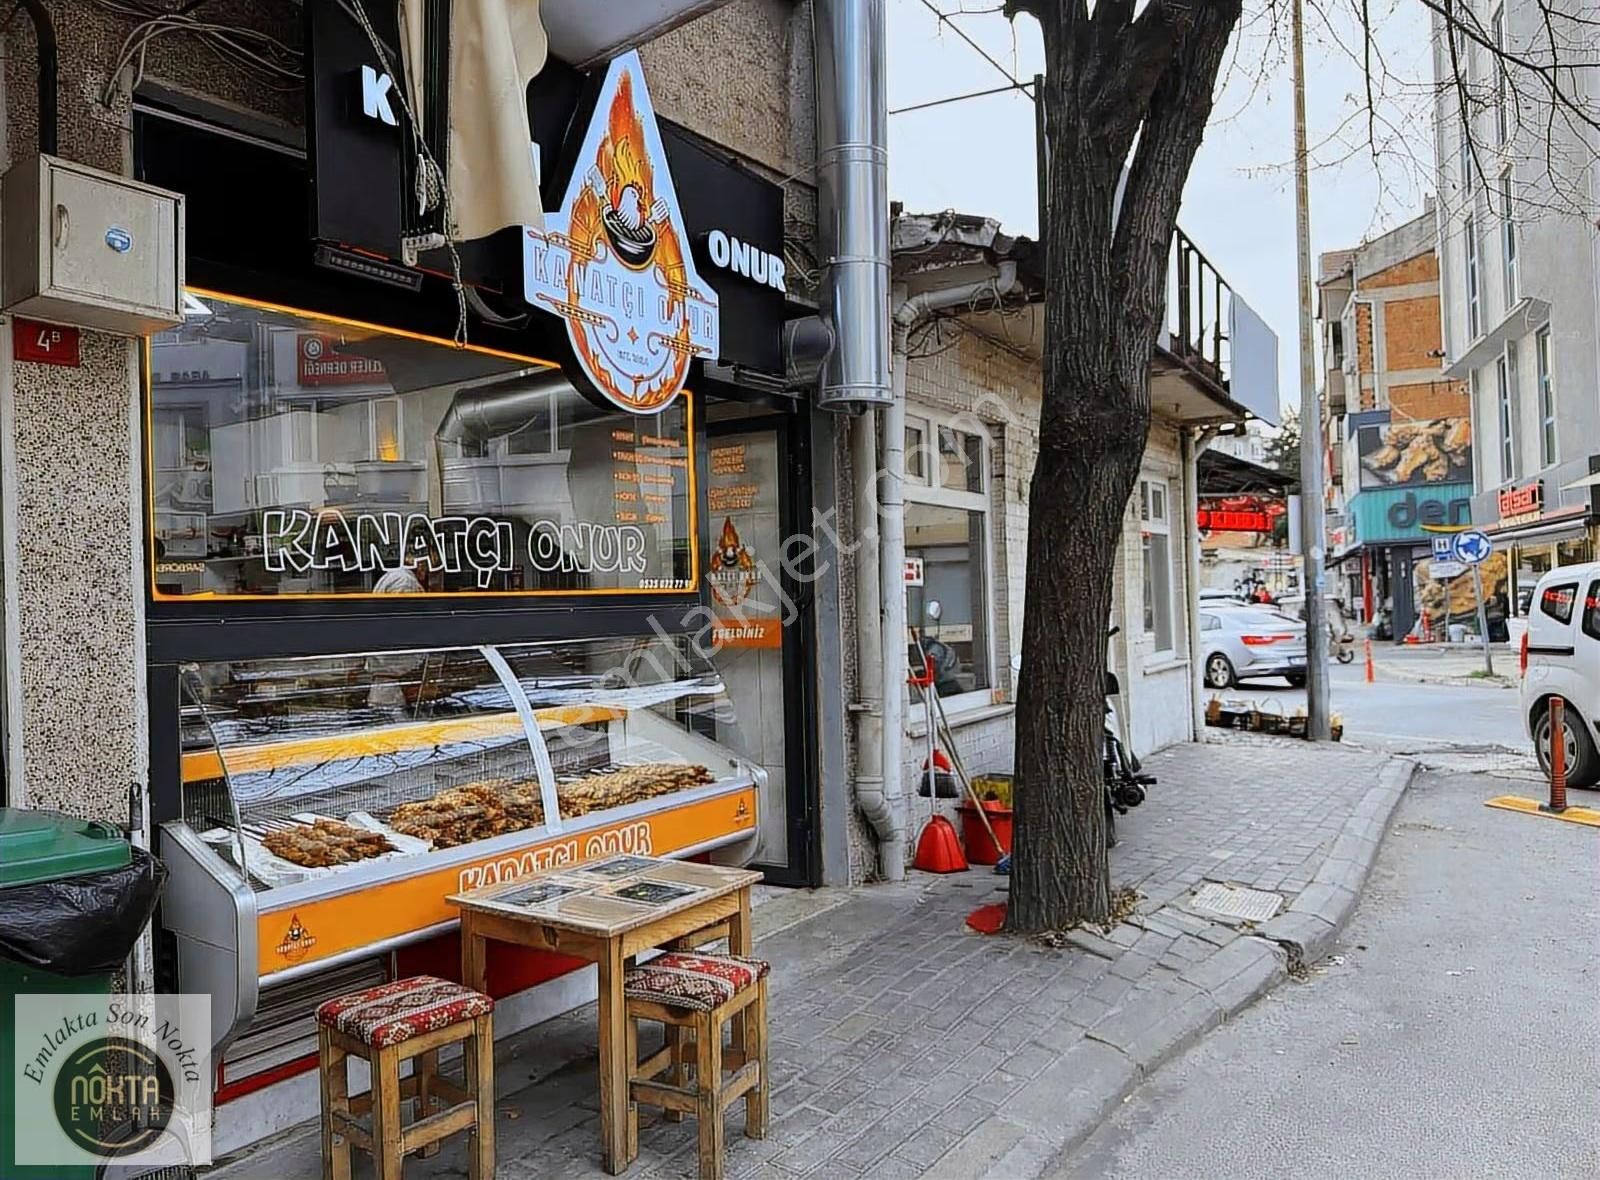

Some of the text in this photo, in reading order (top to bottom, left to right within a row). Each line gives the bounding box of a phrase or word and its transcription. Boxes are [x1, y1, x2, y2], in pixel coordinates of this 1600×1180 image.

[534, 246, 714, 341] KANATÇI ONUR
[708, 229, 787, 293] ONUR
[263, 509, 647, 588] KANATÇI ONUR
